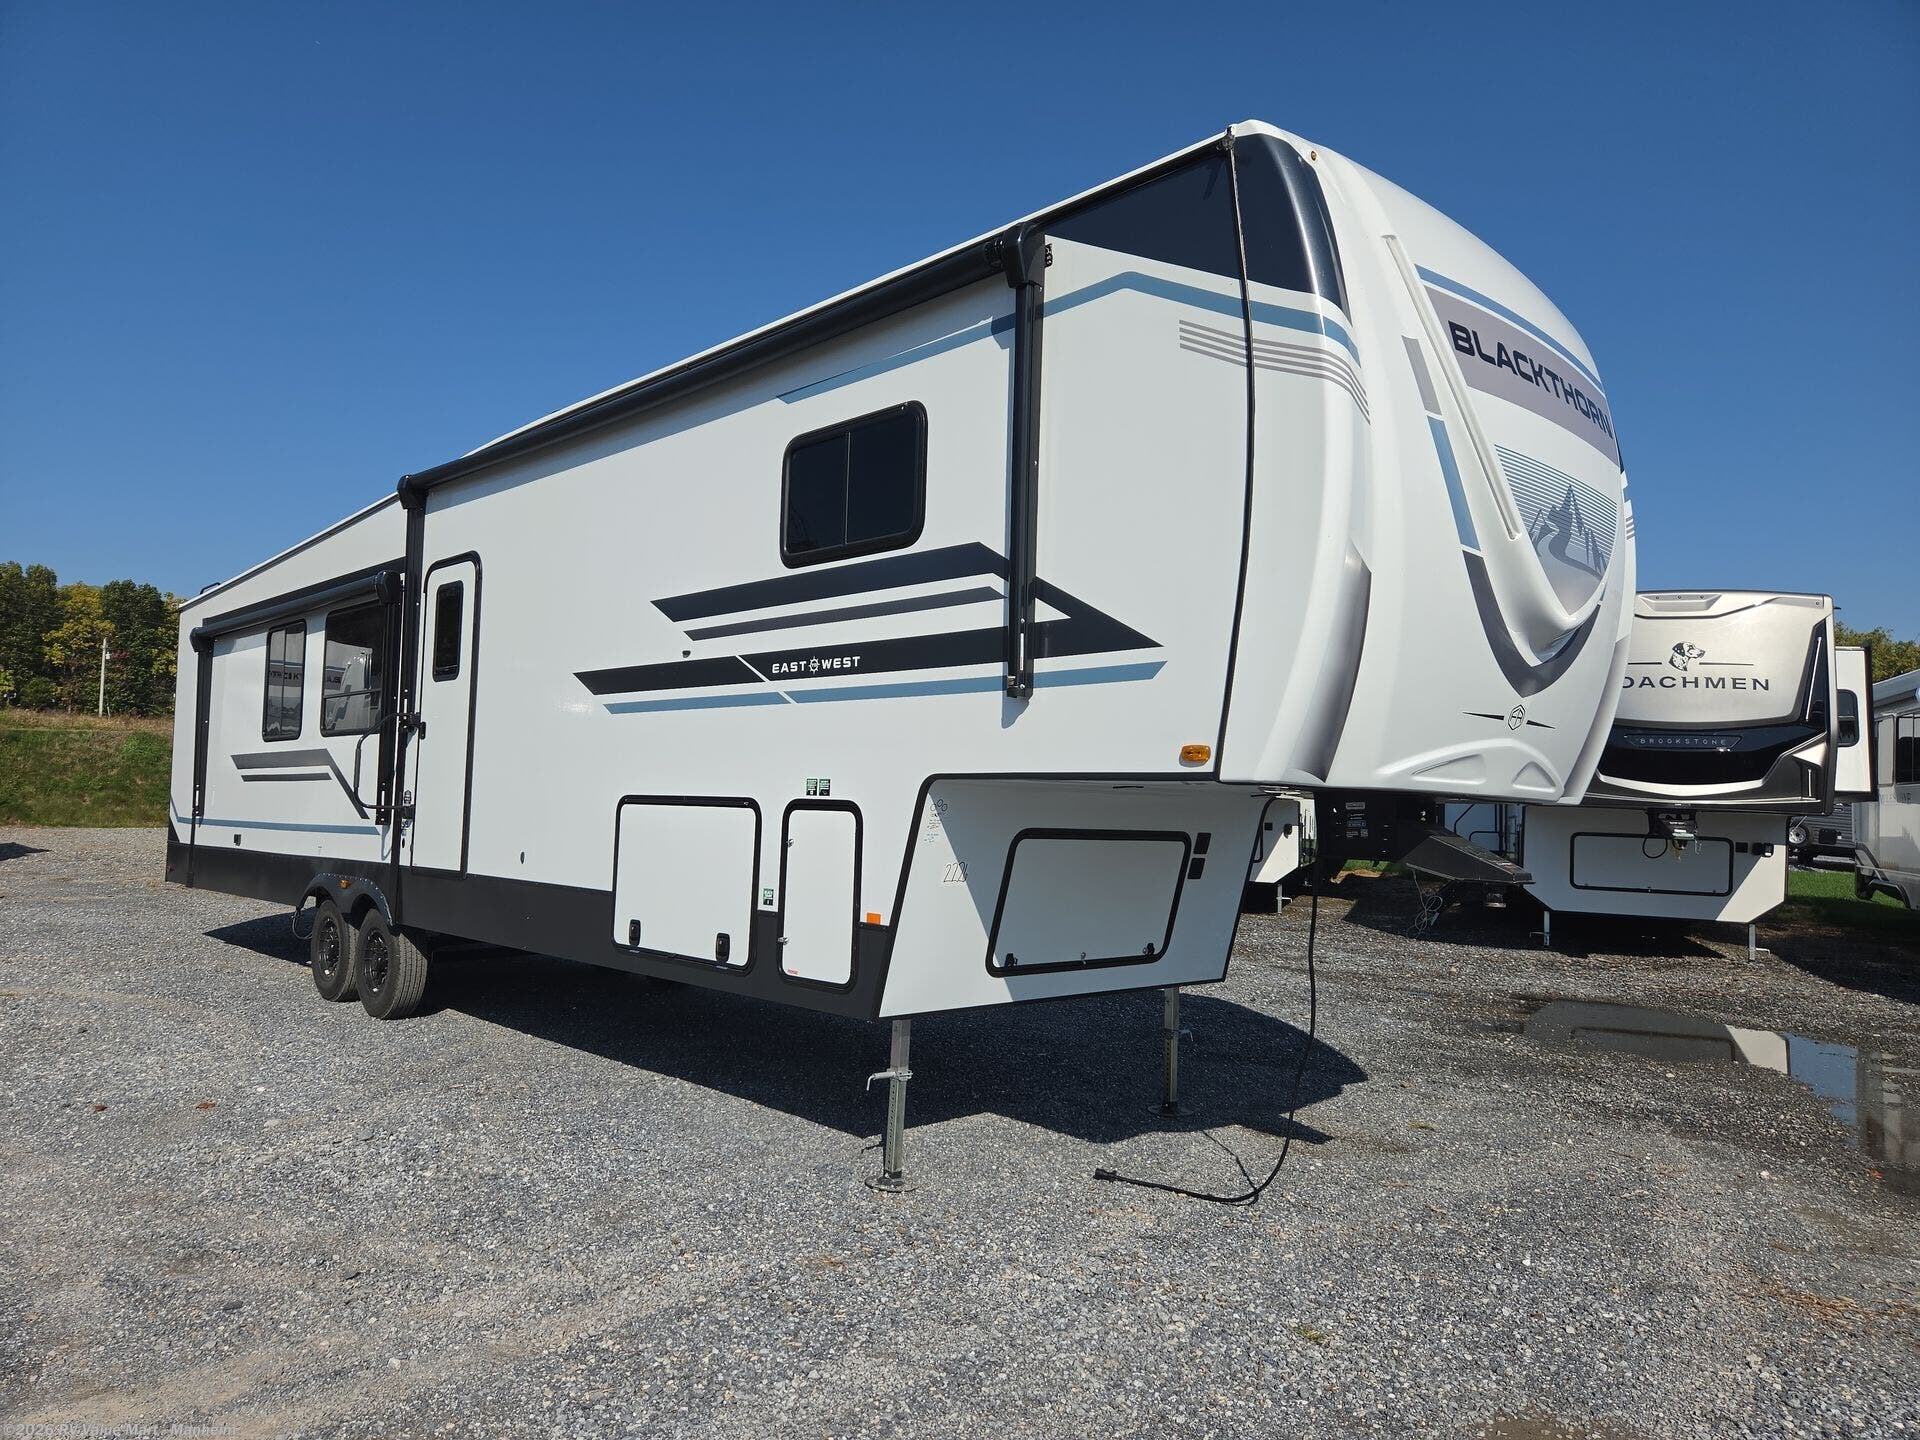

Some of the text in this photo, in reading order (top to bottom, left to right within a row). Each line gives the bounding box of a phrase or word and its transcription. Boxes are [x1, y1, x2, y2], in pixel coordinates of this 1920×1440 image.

[1447, 320, 1614, 440] BLACKTHORN
[771, 655, 861, 674] EAST WEST
[1622, 675, 1770, 691] OACHMEN
[1639, 737, 1727, 747] BROOKSTONE
